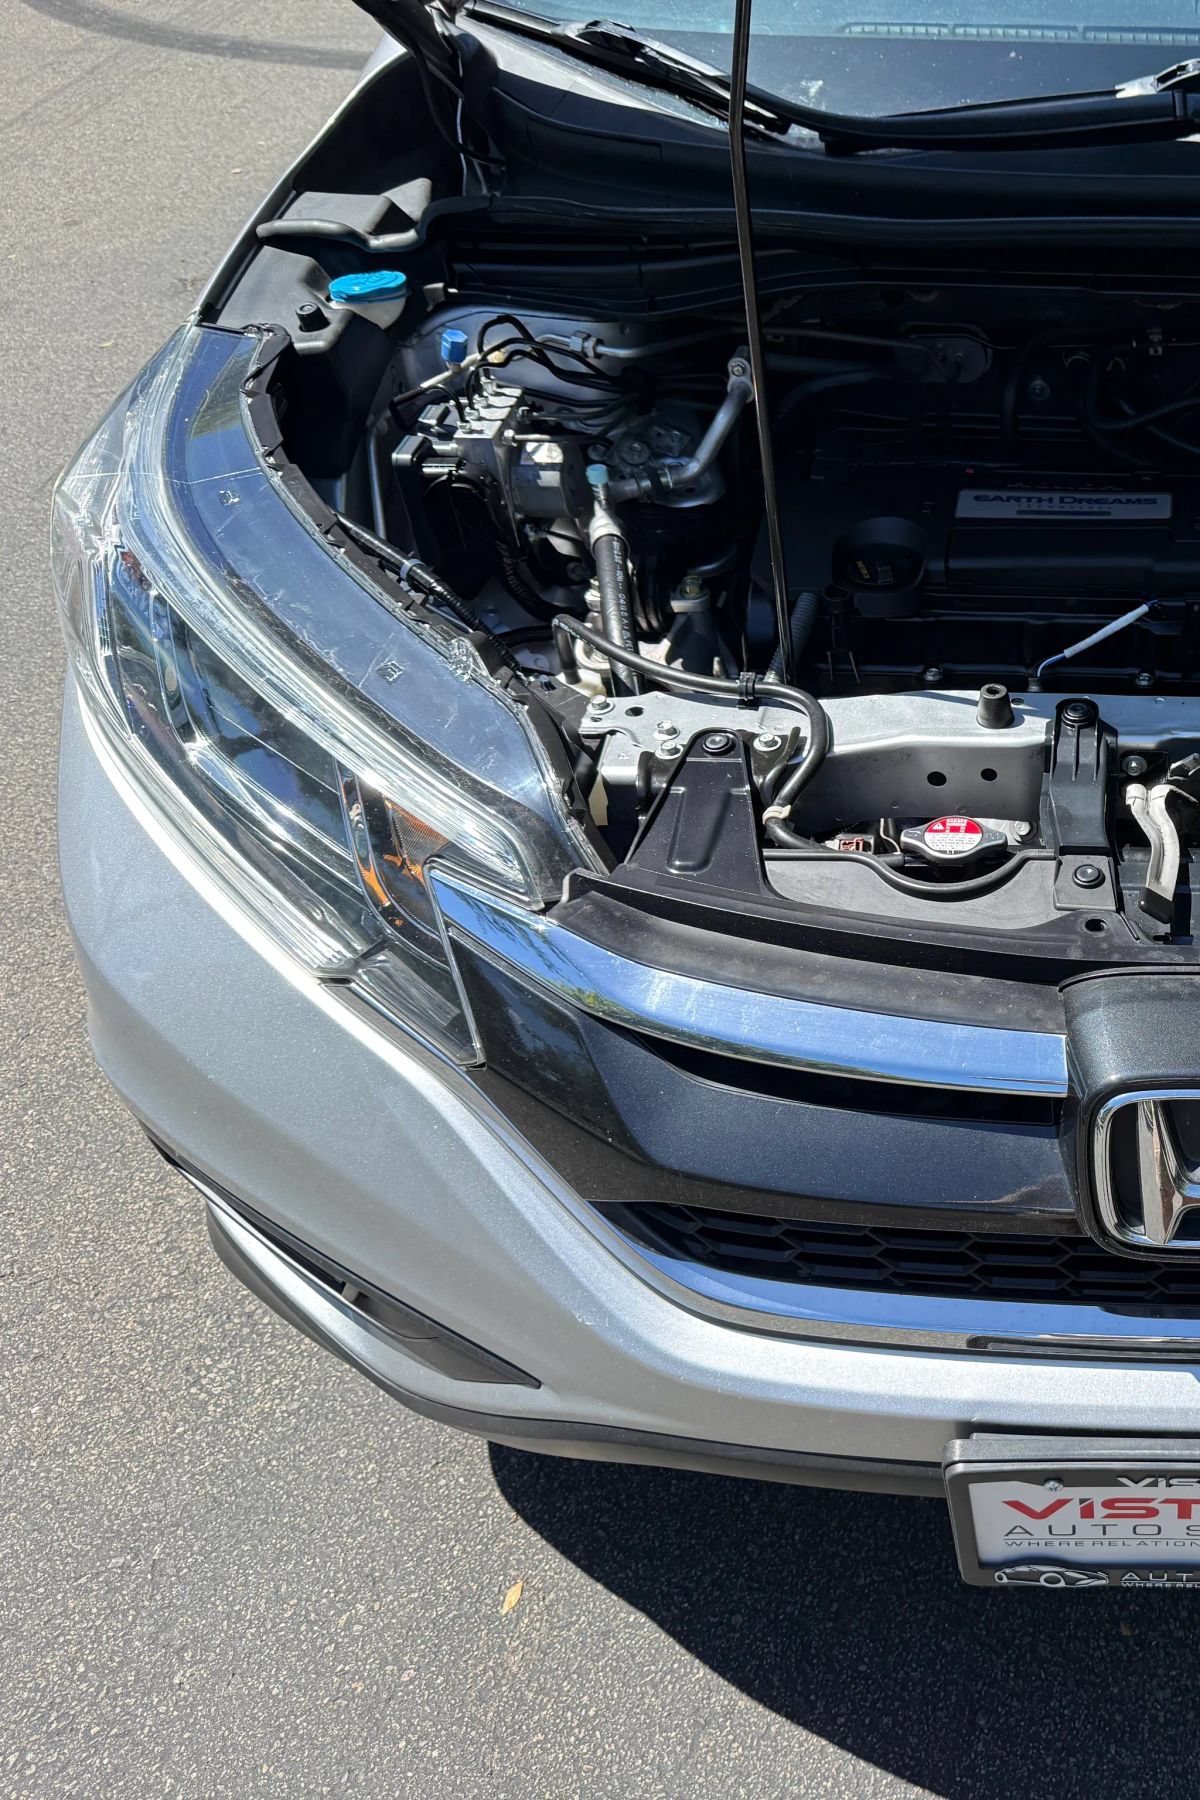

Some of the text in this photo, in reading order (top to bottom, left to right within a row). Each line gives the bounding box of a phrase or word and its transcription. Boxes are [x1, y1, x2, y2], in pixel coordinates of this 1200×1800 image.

[973, 495, 1158, 505] EARTH DREAMS
[1004, 1523, 1162, 1537] AUTO
